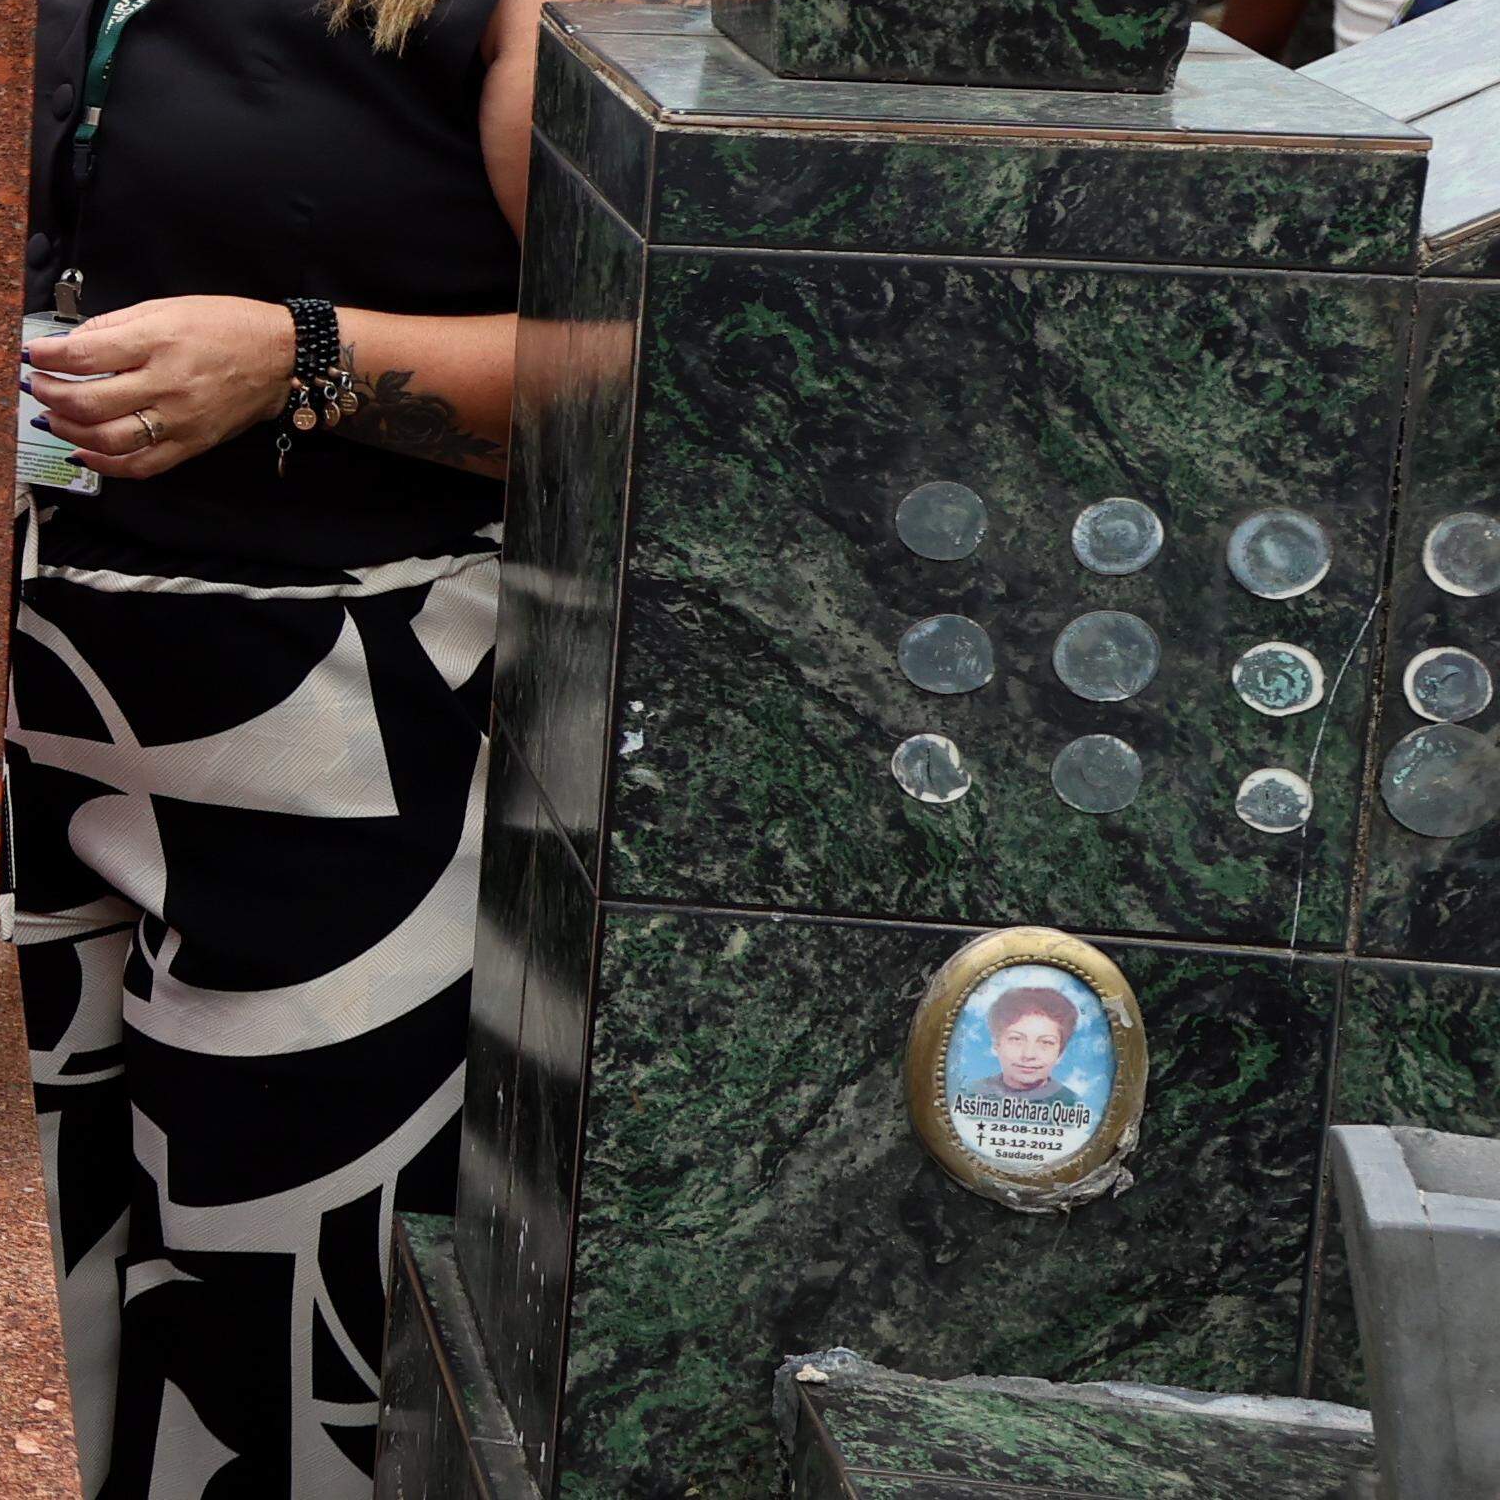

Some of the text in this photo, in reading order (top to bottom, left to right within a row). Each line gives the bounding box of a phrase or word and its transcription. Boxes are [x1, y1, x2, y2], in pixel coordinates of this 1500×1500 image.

[953, 1093, 1091, 1129] Assima Bichara Queija
[990, 1123, 1064, 1137] 28-08-1933
[989, 1137, 1064, 1151] 13-12-2012
[994, 1149, 1045, 1162] Saudades
